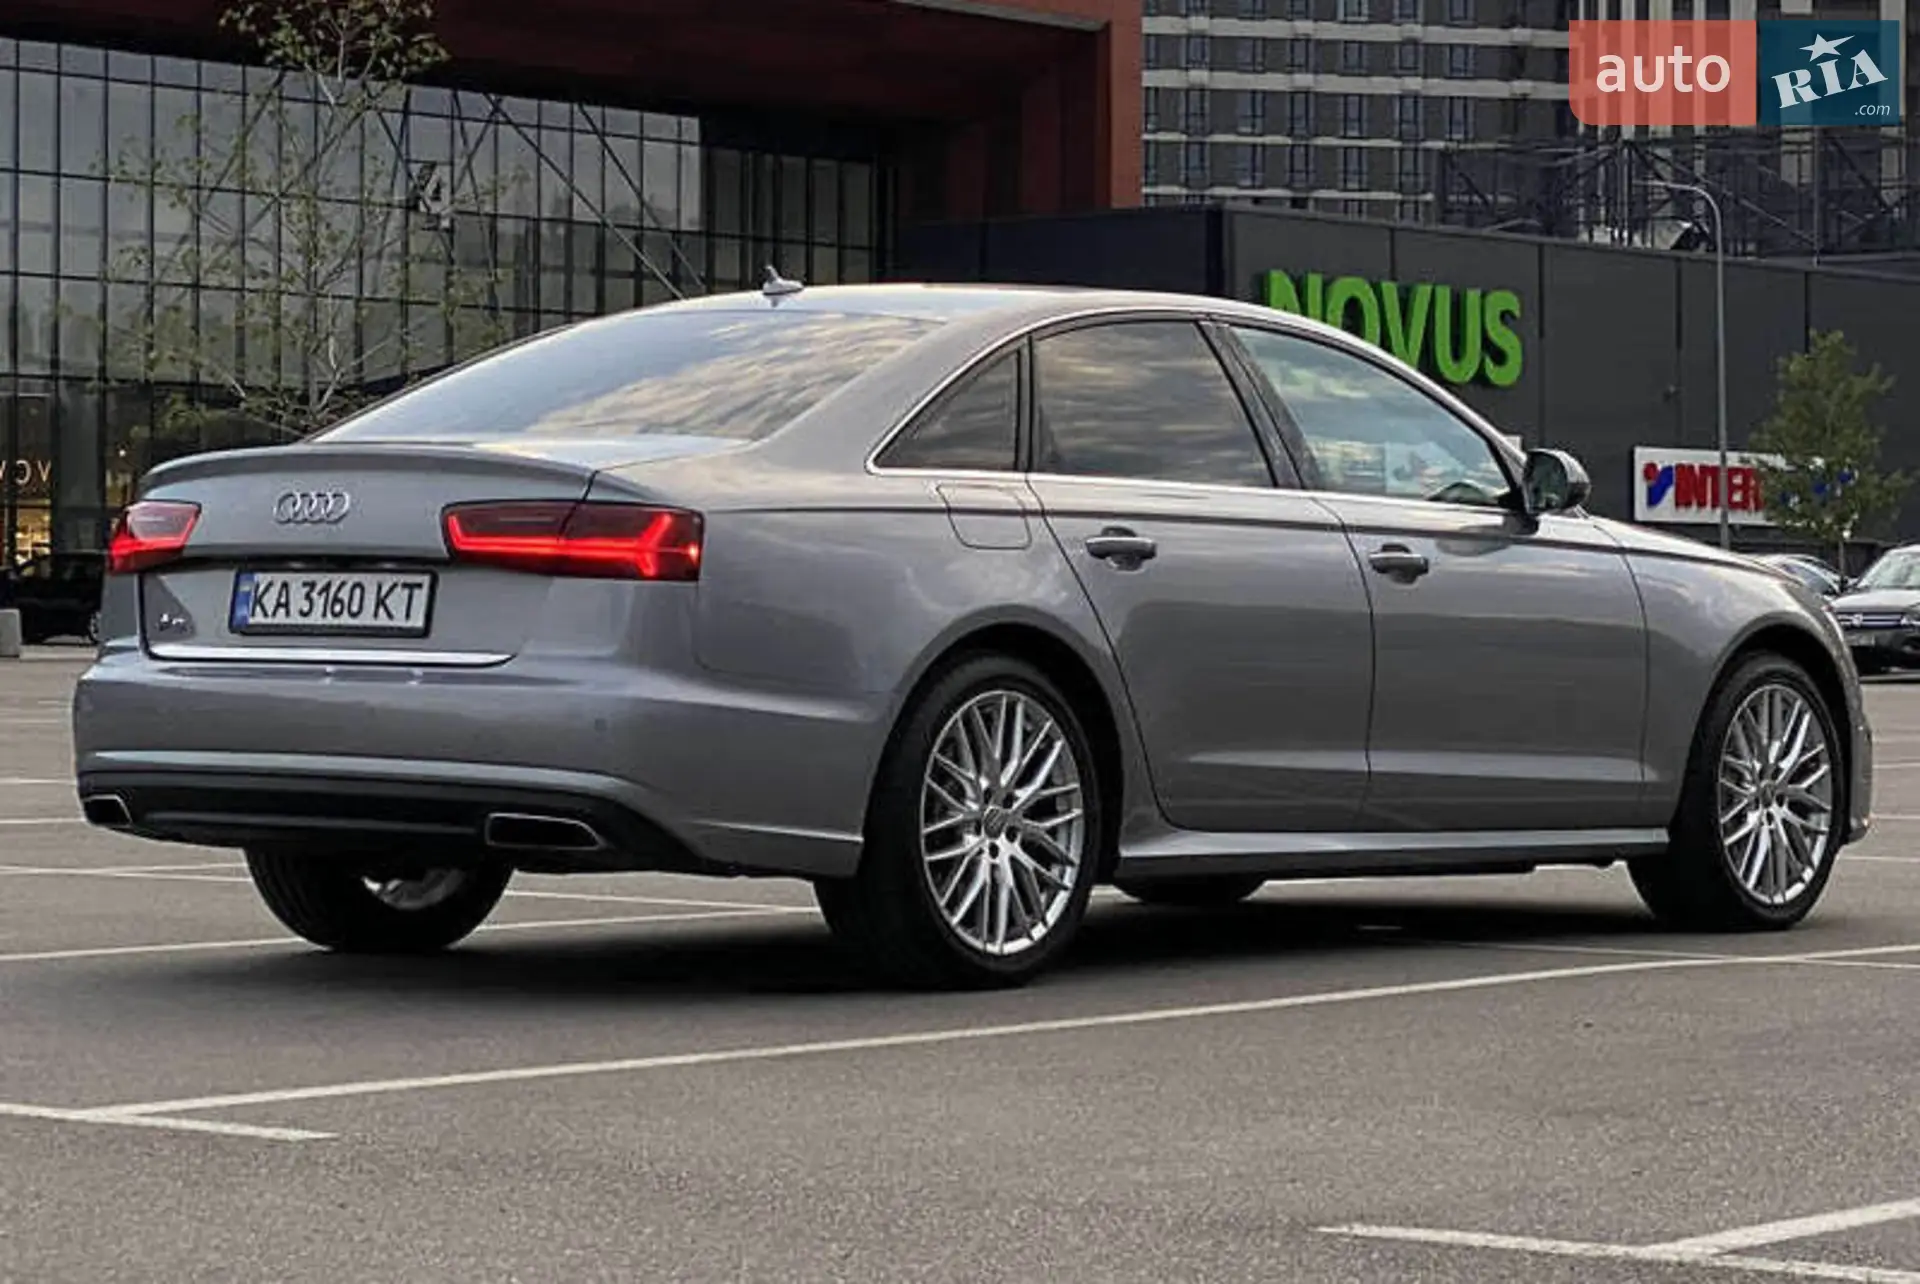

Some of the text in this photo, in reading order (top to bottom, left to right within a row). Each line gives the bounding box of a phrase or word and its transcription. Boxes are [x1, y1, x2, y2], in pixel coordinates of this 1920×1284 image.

[251, 580, 291, 619] KA
[298, 580, 366, 619] 3160
[373, 581, 424, 621] KT
